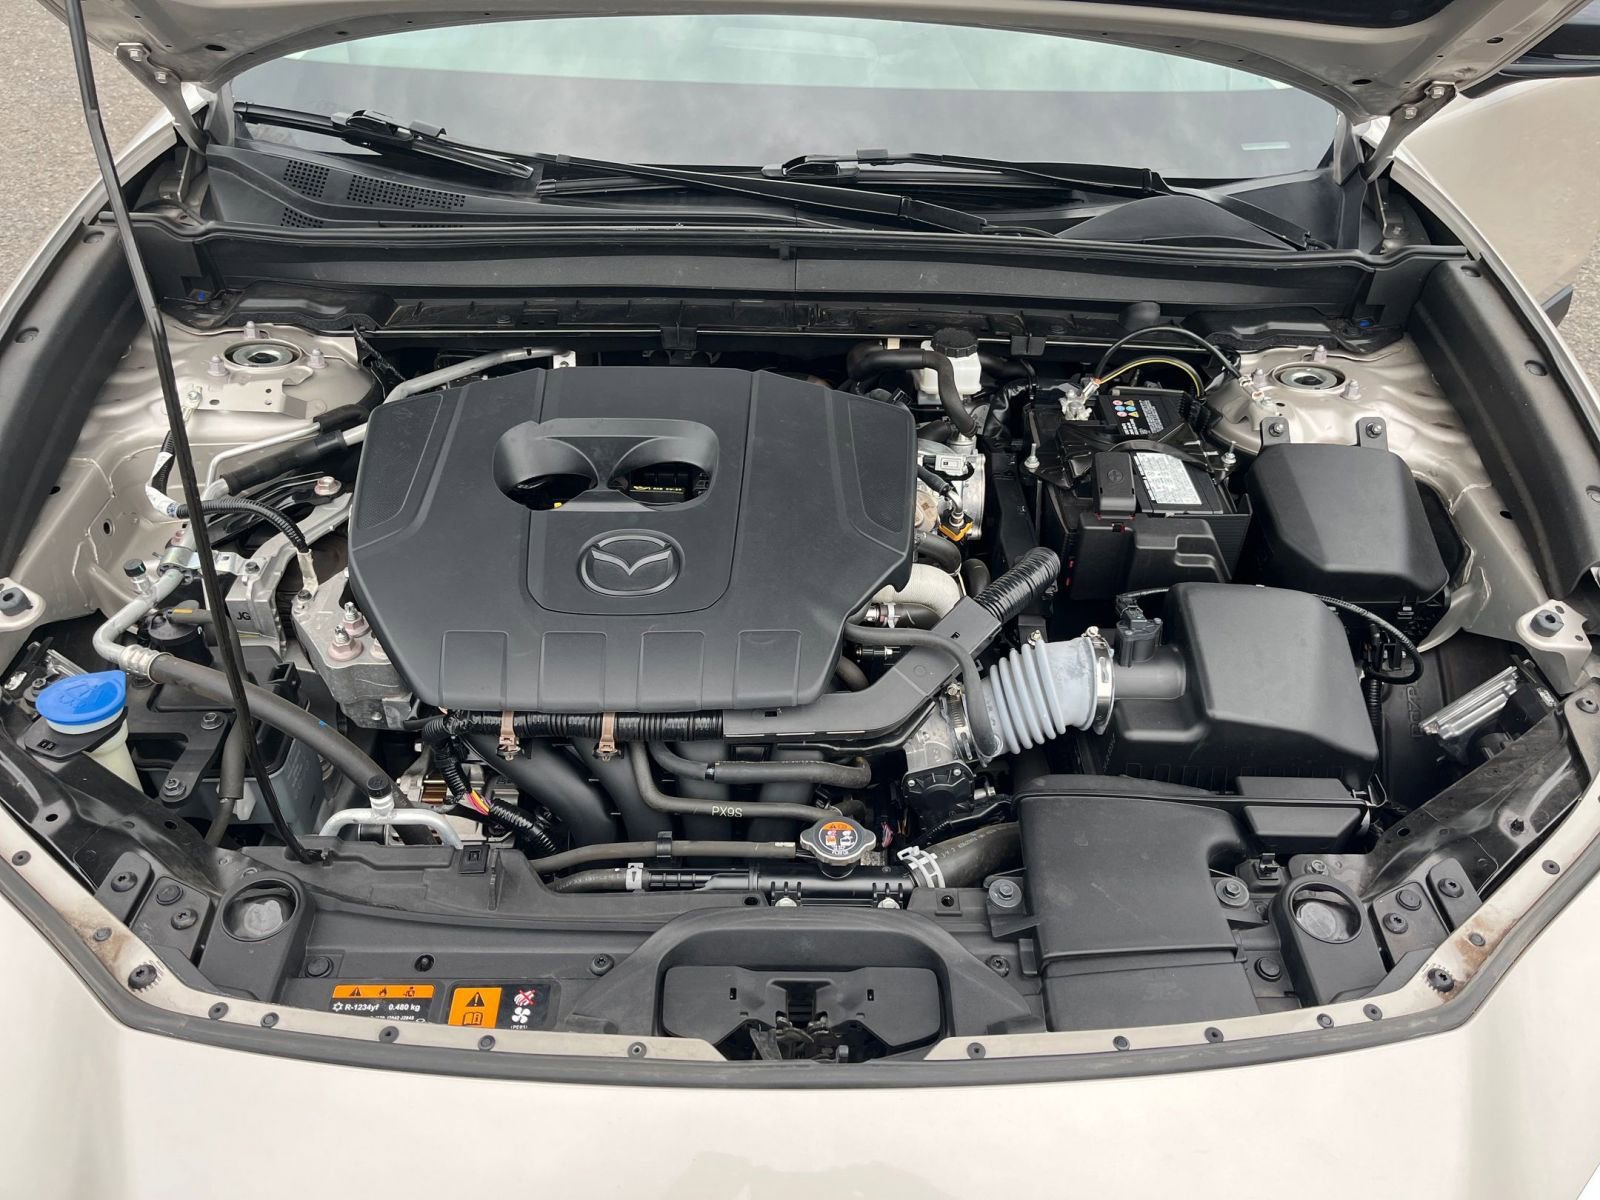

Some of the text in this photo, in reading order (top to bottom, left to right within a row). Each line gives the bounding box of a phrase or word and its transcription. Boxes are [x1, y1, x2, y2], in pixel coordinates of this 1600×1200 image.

[236, 611, 251, 621] JG
[711, 805, 743, 818] PX9S
[344, 1003, 421, 1013] R-1234yf 0.480 kg
